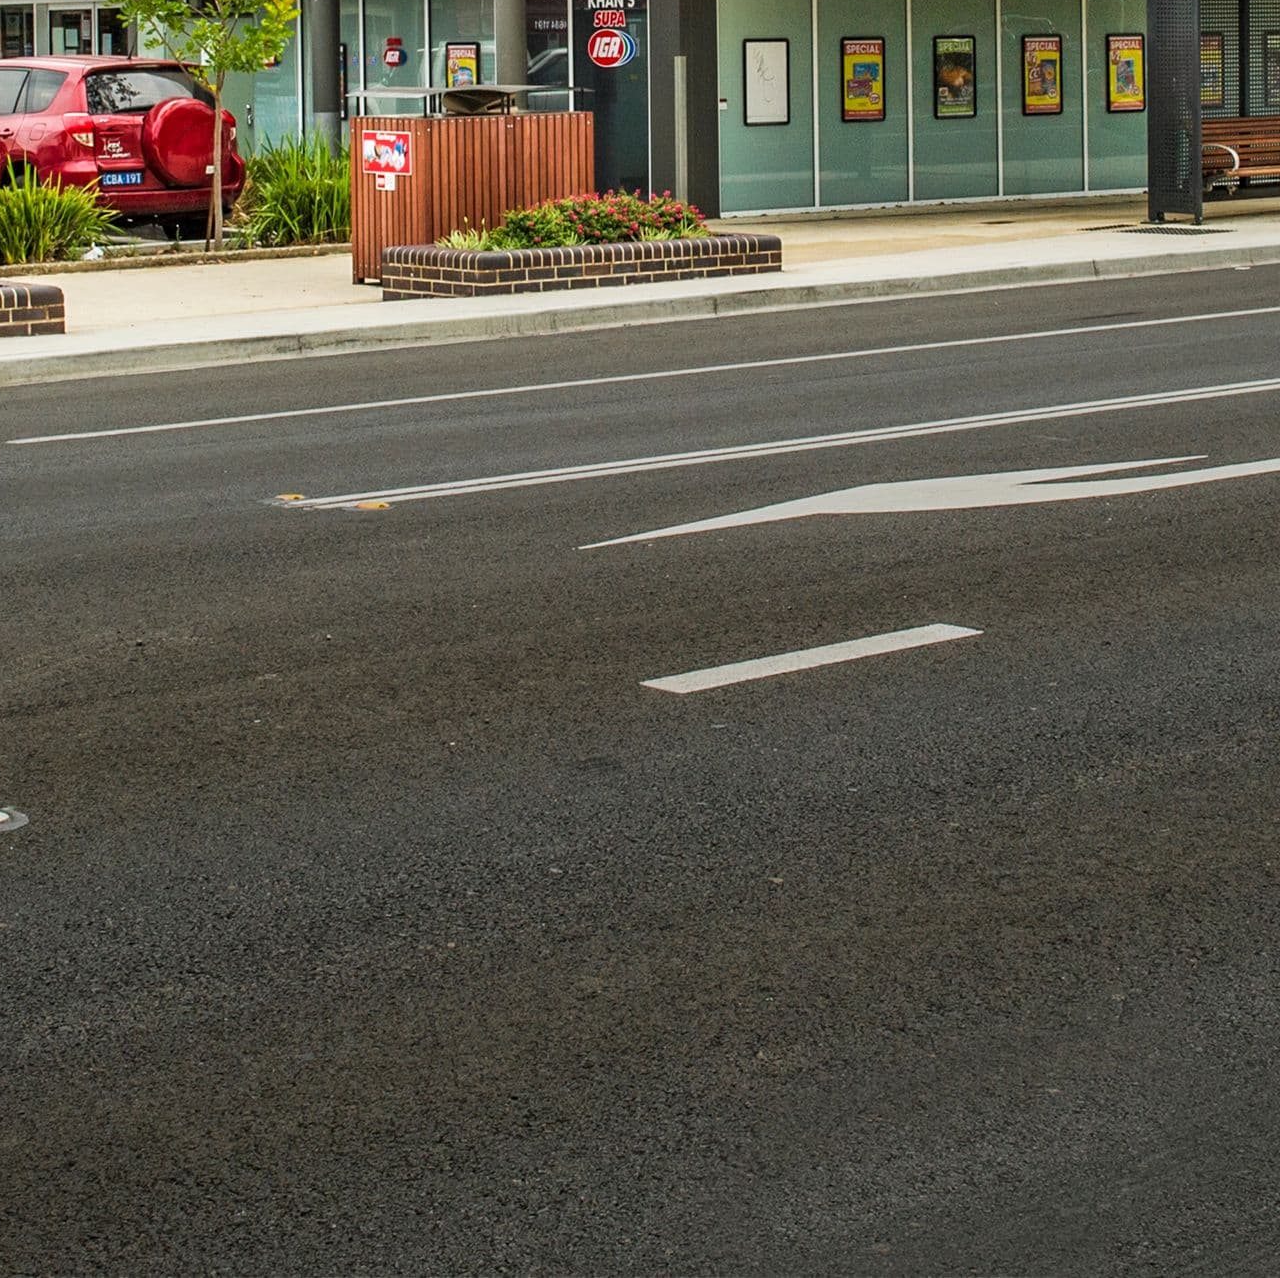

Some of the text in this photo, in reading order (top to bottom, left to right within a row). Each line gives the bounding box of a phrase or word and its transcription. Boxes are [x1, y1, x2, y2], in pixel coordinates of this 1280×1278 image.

[593, 10, 626, 27] SUPA
[592, 37, 620, 58] IGA
[846, 44, 880, 54] SPECIAL
[1026, 42, 1057, 51] SPECIAL
[1110, 41, 1140, 49] SPECIAL
